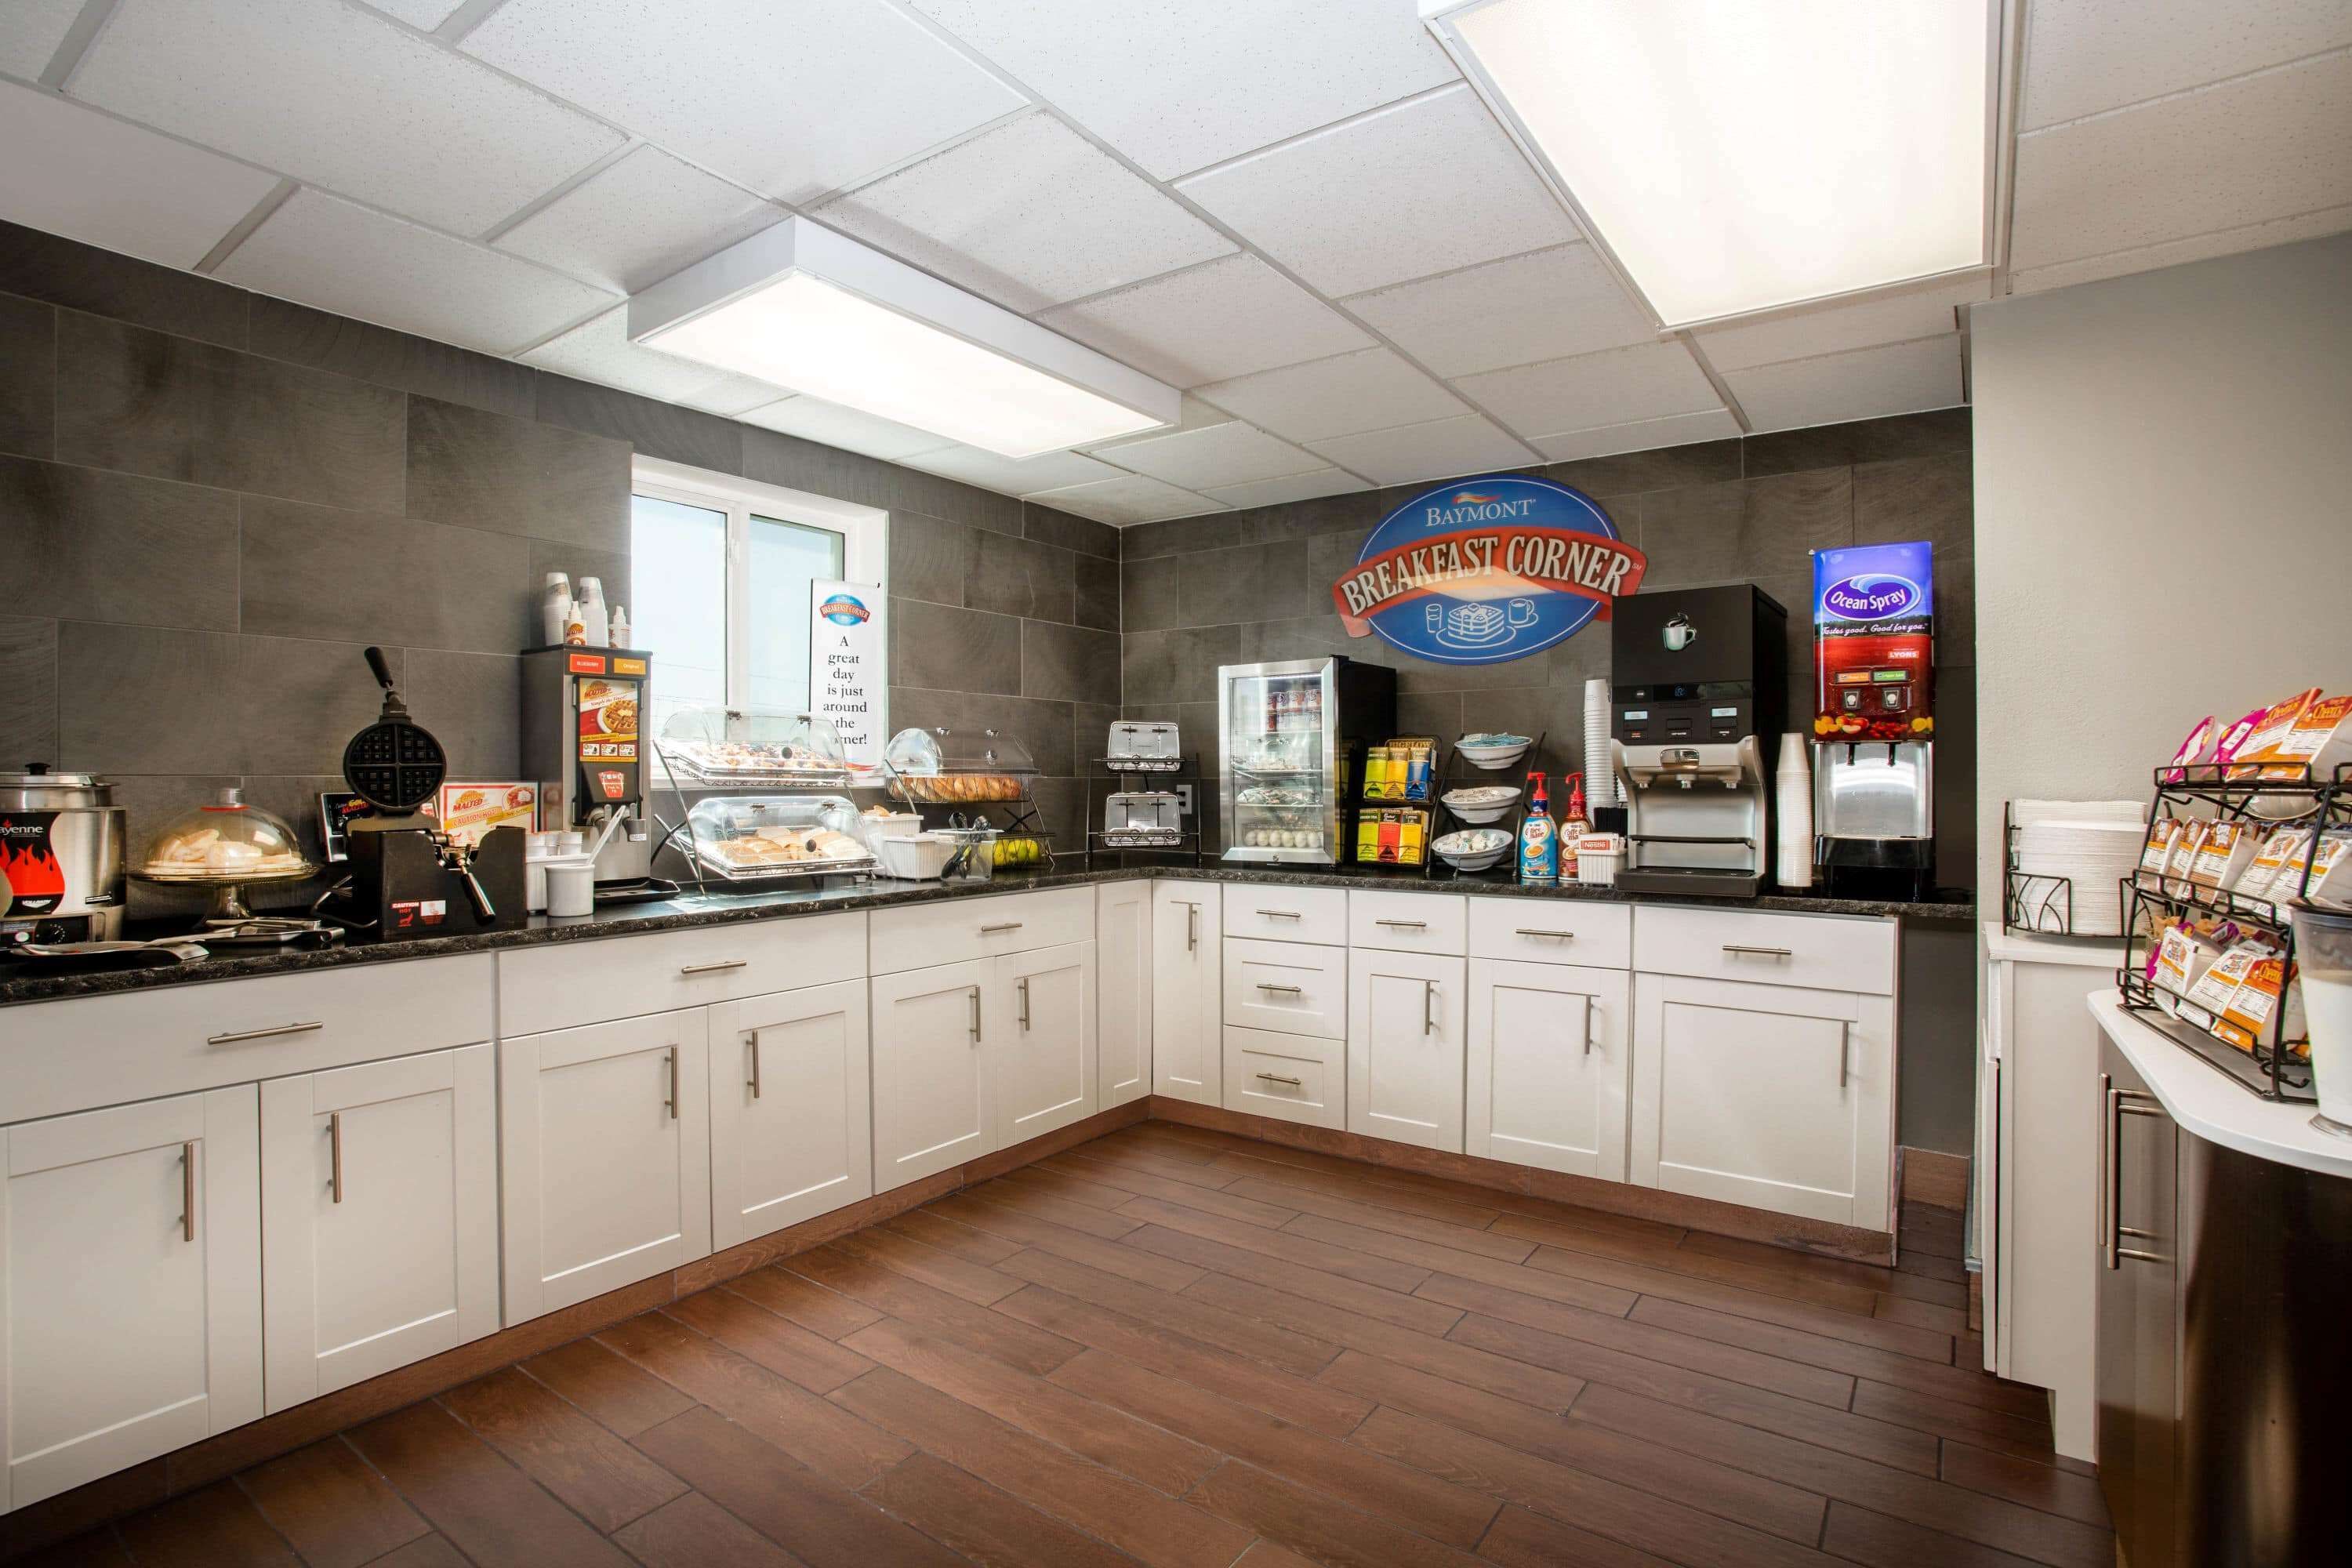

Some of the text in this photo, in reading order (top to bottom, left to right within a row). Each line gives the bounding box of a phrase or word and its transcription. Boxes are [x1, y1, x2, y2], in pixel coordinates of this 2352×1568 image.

[1425, 499, 1531, 527] BAYMONT
[1341, 535, 1631, 616] BREAKFAST CORNER
[1831, 589, 1906, 612] Ocean Spray
[821, 603, 848, 615] BREAKFAST
[1844, 625, 1867, 636] good.
[1871, 624, 1892, 633] Good
[1893, 623, 1906, 632] for
[840, 636, 848, 647] A
[828, 654, 860, 666] great
[833, 667, 855, 683] day
[828, 684, 863, 699] is just
[823, 702, 867, 713] around
[836, 717, 855, 728] the
[834, 734, 867, 745] ner!
[0, 826, 45, 836] ayenne
